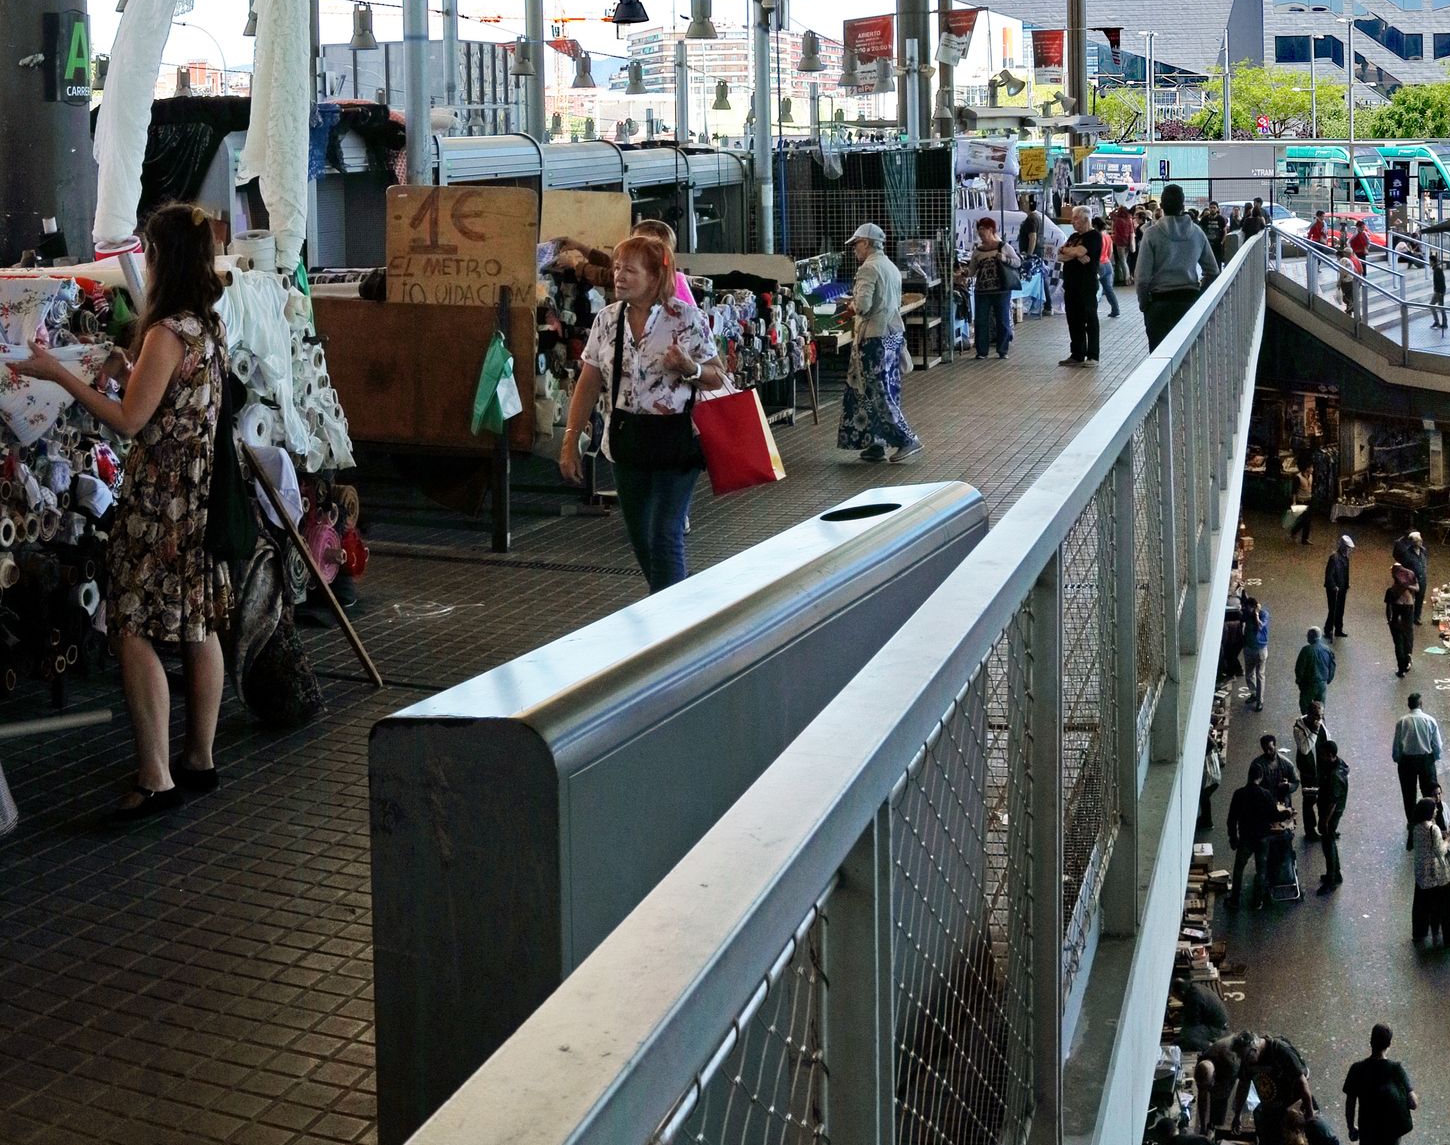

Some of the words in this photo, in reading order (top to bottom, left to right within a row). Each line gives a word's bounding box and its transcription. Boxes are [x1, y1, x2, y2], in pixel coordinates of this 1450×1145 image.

[858, 30, 881, 38] ABIERTO
[64, 22, 90, 79] A
[1258, 168, 1275, 176] TRAM
[388, 256, 416, 278] EL
[423, 257, 503, 278] METRO
[1221, 980, 1246, 1002] 31
